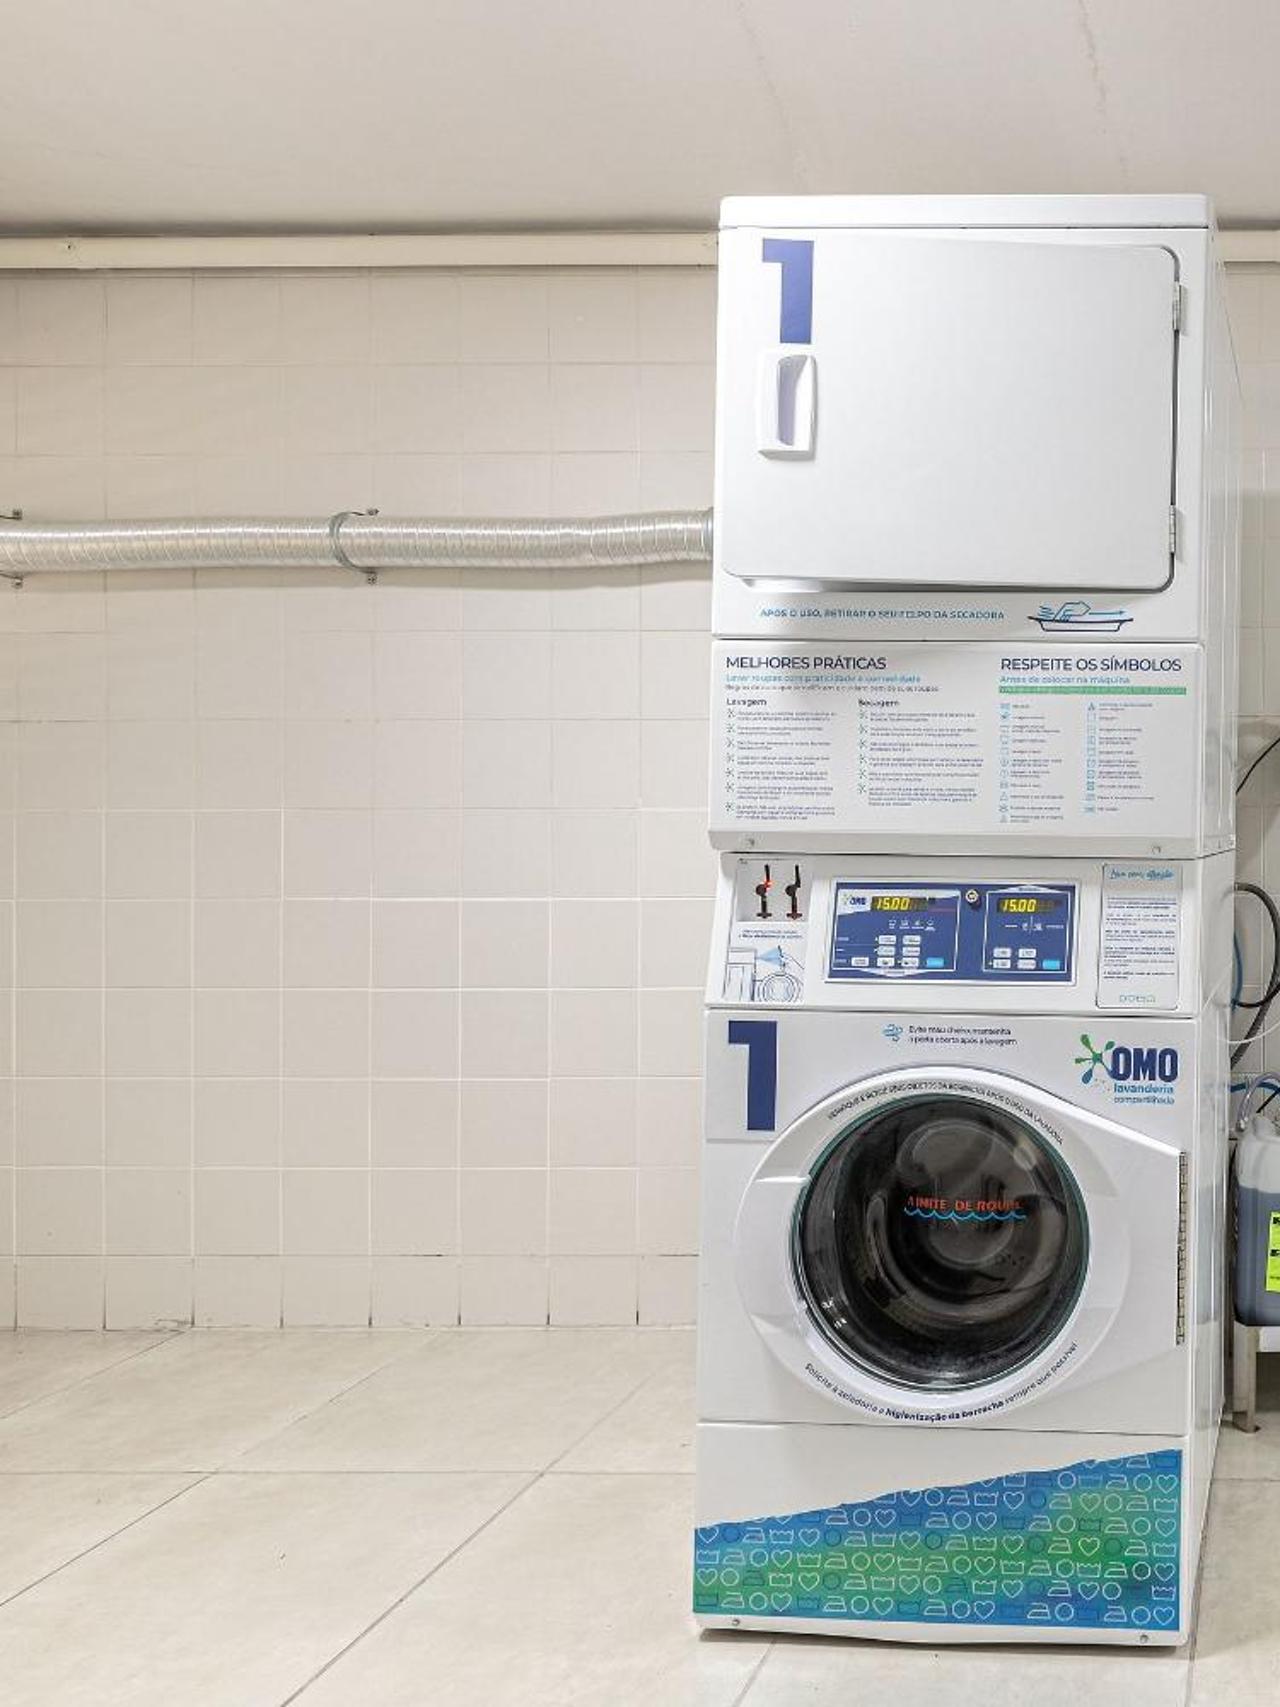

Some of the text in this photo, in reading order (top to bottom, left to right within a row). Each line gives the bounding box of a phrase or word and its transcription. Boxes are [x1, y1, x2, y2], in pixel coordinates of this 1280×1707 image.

[762, 238, 814, 344] 1
[790, 608, 797, 617] O
[868, 609, 876, 618] O
[934, 610, 948, 619] DA
[950, 610, 1004, 620] SECADORA
[726, 654, 887, 670] MELHORES PRÁTICAS
[1001, 654, 1182, 672] RESPEITE OS SÍMBOLOS
[1042, 675, 1074, 684] colocar
[1076, 676, 1088, 684] na
[1090, 675, 1130, 684] máquina
[909, 1025, 927, 1034] Evite
[985, 1038, 1018, 1046] lavagem
[1110, 1046, 1178, 1082] OMO
[728, 1020, 778, 1131] 1
[1114, 1083, 1174, 1094] lavanderia
[886, 1408, 946, 1422] higienização
[948, 1411, 960, 1420] da
[962, 1400, 1004, 1418] borracha
